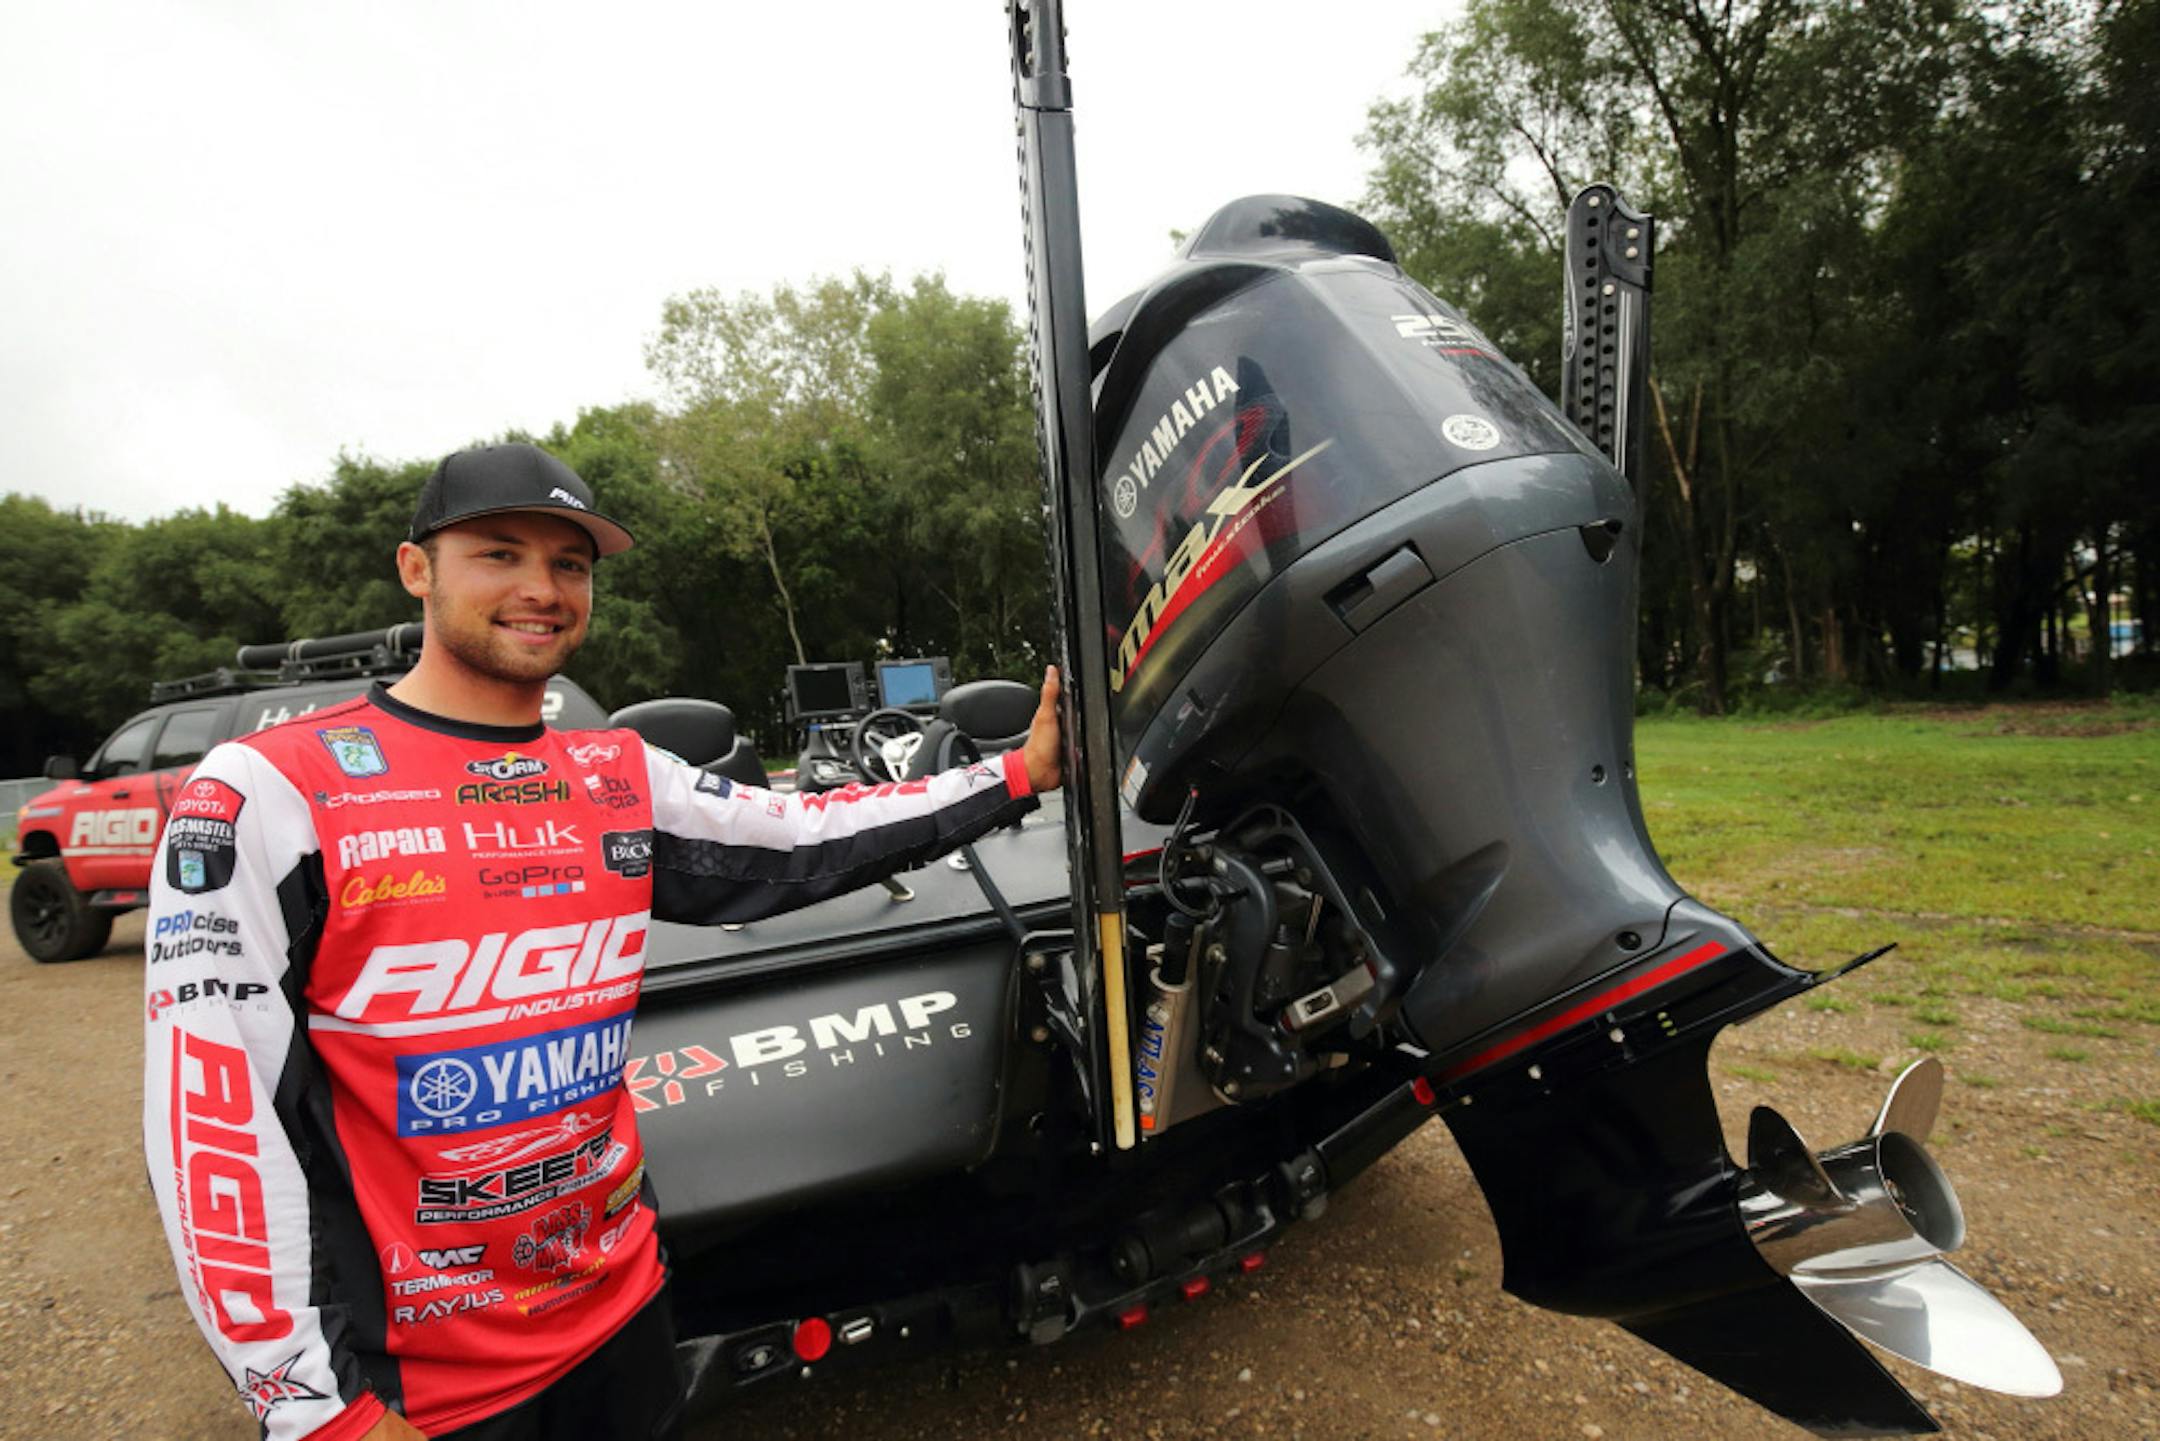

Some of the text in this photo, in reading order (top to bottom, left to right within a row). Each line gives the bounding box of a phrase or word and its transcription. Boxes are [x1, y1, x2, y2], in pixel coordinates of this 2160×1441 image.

[1129, 365, 1240, 488] YAMAHA
[473, 760, 545, 778] STORM
[456, 780, 571, 805] ARASHI
[69, 808, 158, 847] RIGID
[463, 820, 584, 850] Huk
[340, 870, 447, 908] Cabela's
[480, 866, 584, 886] GoPro
[334, 909, 651, 1019] RIGID
[508, 979, 639, 1021] INDUSTRIES
[729, 991, 958, 1069] BMP
[705, 1022, 972, 1096] FISHING
[411, 1071, 624, 1131] PRO FISHIN
[185, 1032, 294, 1344] RIGID
[419, 1188, 556, 1222] PERFORMANCE
